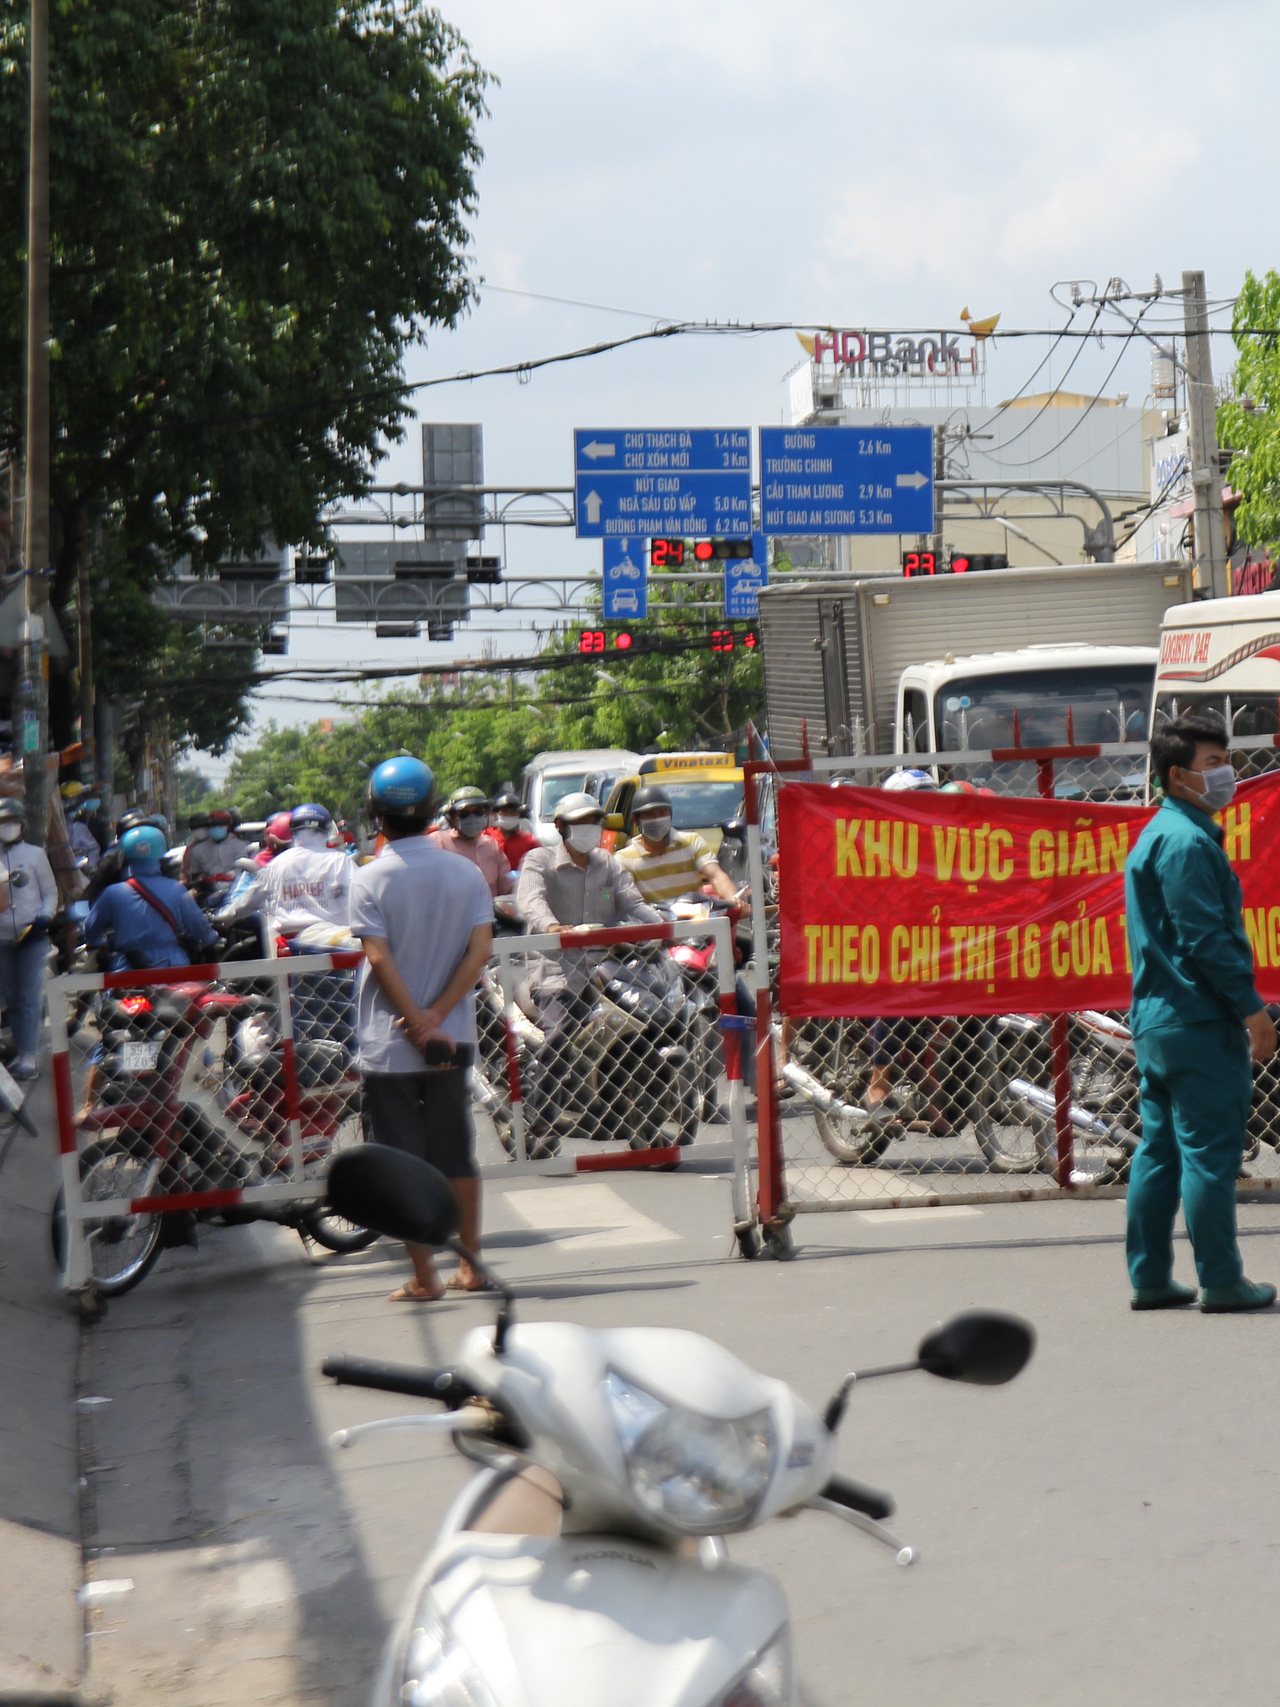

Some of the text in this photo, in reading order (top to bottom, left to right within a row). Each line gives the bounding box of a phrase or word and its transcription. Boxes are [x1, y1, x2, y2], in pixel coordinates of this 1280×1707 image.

[814, 331, 961, 363] HDBank
[679, 430, 692, 448] ĐÀ
[732, 433, 748, 447] Km
[859, 440, 874, 455] 2.6
[876, 440, 892, 454] Km
[647, 446, 669, 467] XÓM
[723, 453, 730, 467] 3
[732, 453, 748, 467] Km
[805, 458, 833, 473] CHINH
[636, 473, 680, 493] NÚT GIAO
[786, 484, 811, 499] THAM
[859, 484, 874, 499] 2.9
[876, 484, 892, 499] Km
[642, 493, 661, 512] SÁU
[663, 492, 677, 512] GÒ
[714, 496, 729, 512] 5.0
[732, 497, 748, 511] Km
[715, 518, 731, 533] 6.2
[732, 518, 749, 533] Km
[767, 506, 784, 525] NÚT
[787, 510, 808, 525] GIAO
[810, 510, 822, 525] AN
[859, 510, 874, 525] 5.3
[876, 510, 893, 525] Km
[652, 540, 683, 566] 24
[580, 631, 605, 653] 23
[1161, 633, 1195, 664] LOGISTIC
[663, 755, 730, 768] Vinataxi
[835, 816, 1130, 893] KHU VỰC GIÃN
[805, 924, 878, 984] THEO
[890, 900, 941, 983] CHỈ
[950, 924, 996, 993] THỊ
[1007, 922, 1040, 979] 16
[1050, 901, 1114, 978] CỦA
[574, 1550, 657, 1570] HONDA
